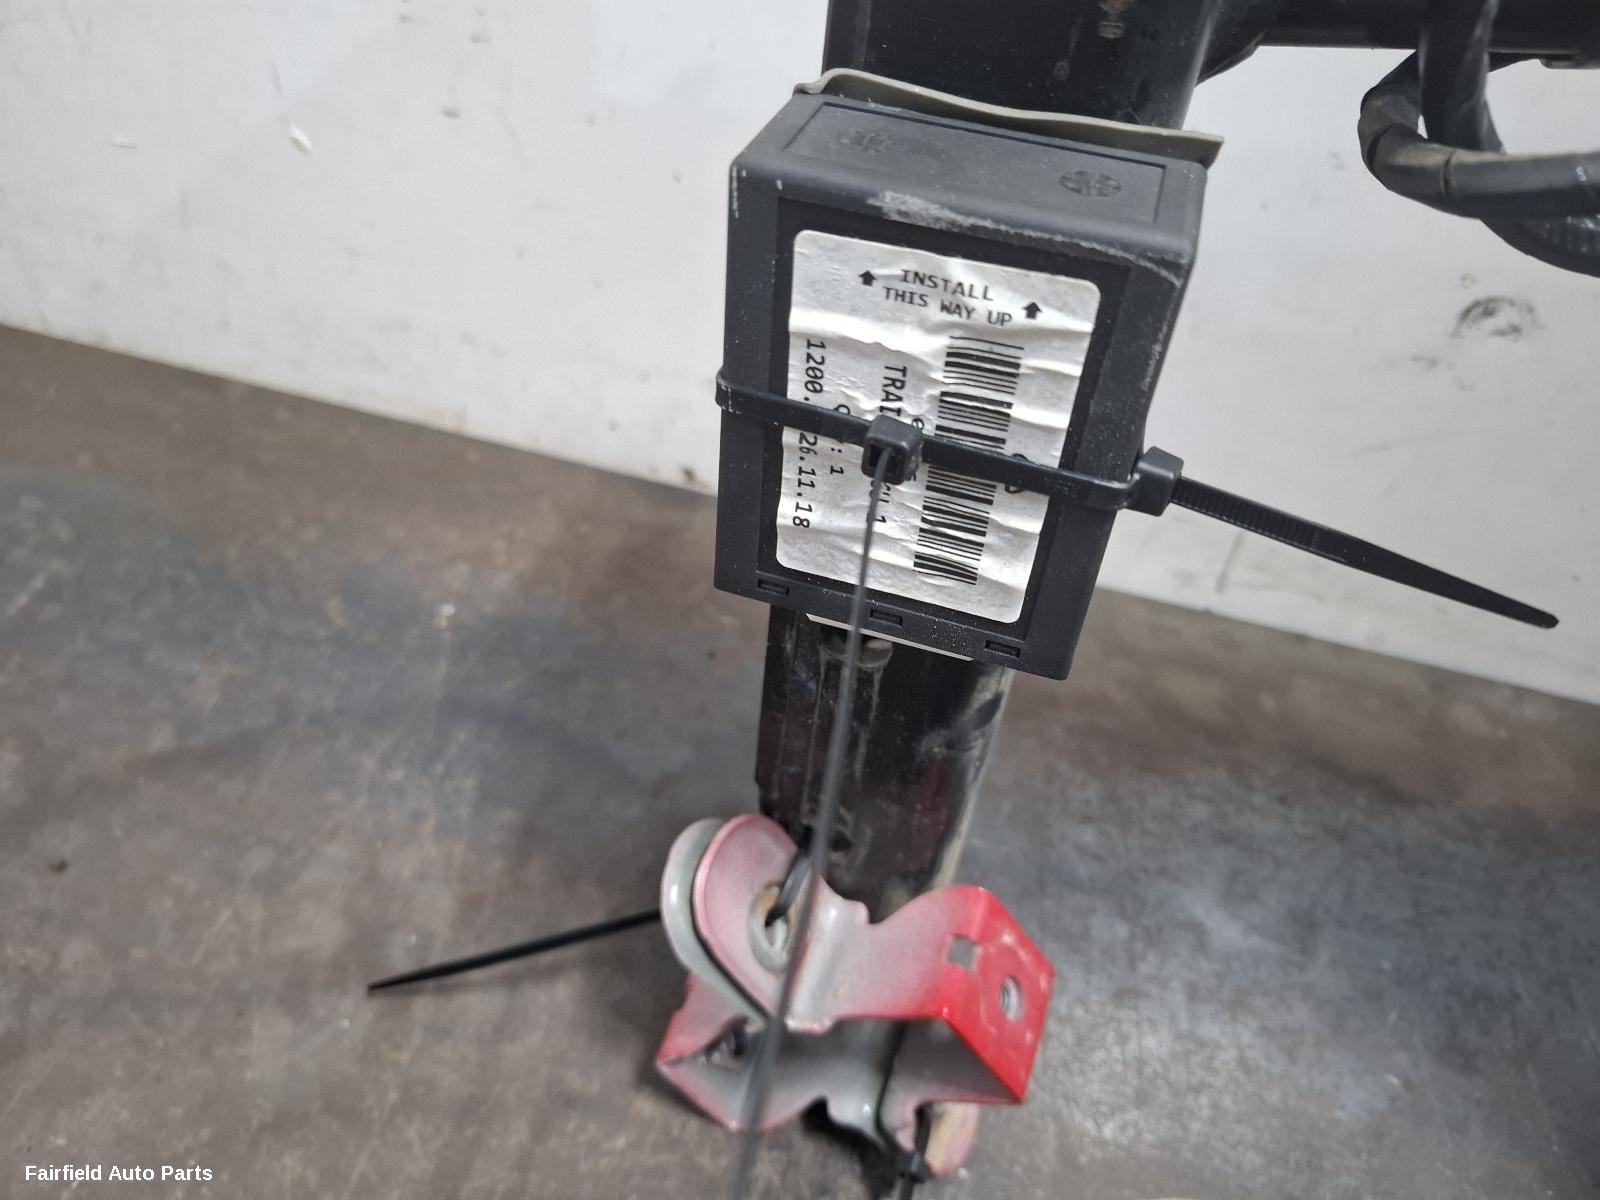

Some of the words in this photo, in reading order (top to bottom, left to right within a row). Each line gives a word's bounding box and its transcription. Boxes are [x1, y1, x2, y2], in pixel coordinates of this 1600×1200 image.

[883, 286, 929, 307] THIS
[940, 299, 975, 320] WAY
[988, 310, 1013, 326] UP
[902, 269, 993, 301] INSTALL
[804, 339, 826, 402] 1200.
[879, 366, 907, 417] TRAI
